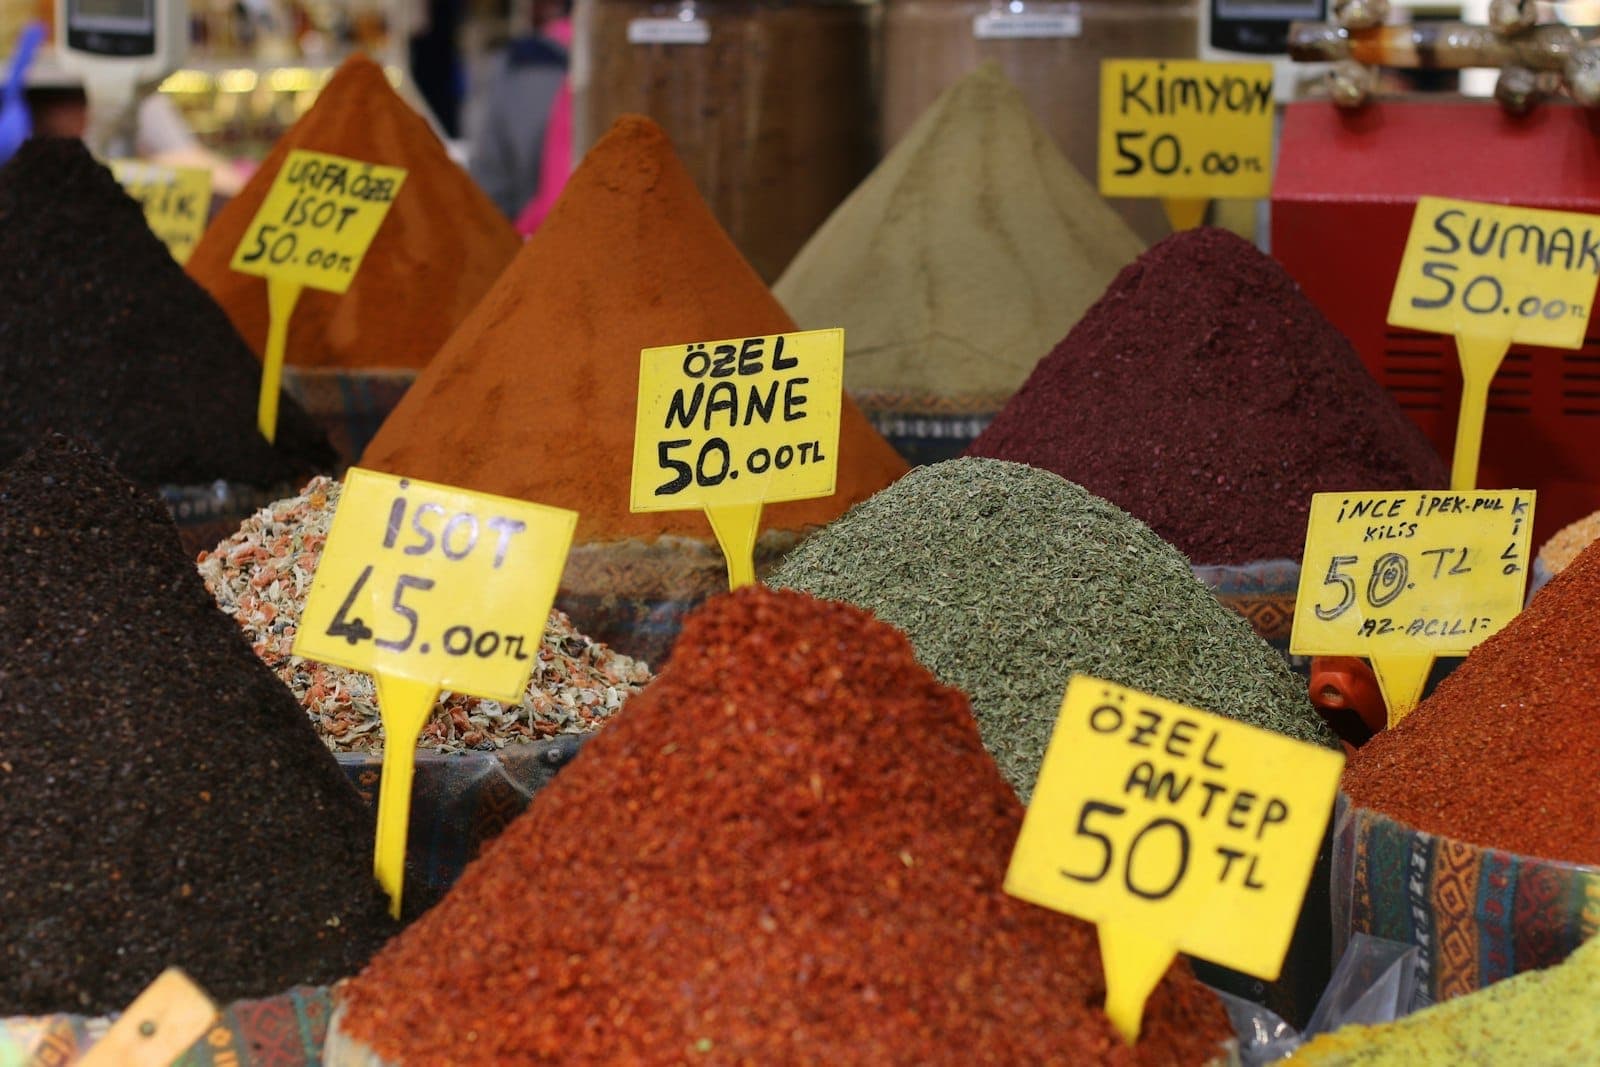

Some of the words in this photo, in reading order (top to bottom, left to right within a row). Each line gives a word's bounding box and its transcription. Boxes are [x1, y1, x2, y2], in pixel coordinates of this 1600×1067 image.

[282, 187, 358, 232] İSOT
[1423, 210, 1600, 275] SUMAK
[683, 336, 798, 378] ÖZEL
[665, 378, 809, 430] NANE
[383, 479, 527, 569] İSOT
[1337, 500, 1406, 522] İNCE
[1421, 547, 1472, 579] TL
[1089, 689, 1226, 771] ÖZEL
[1124, 761, 1289, 840] ANTEP
[1059, 800, 1190, 901] 50
[1216, 846, 1265, 889] TL
